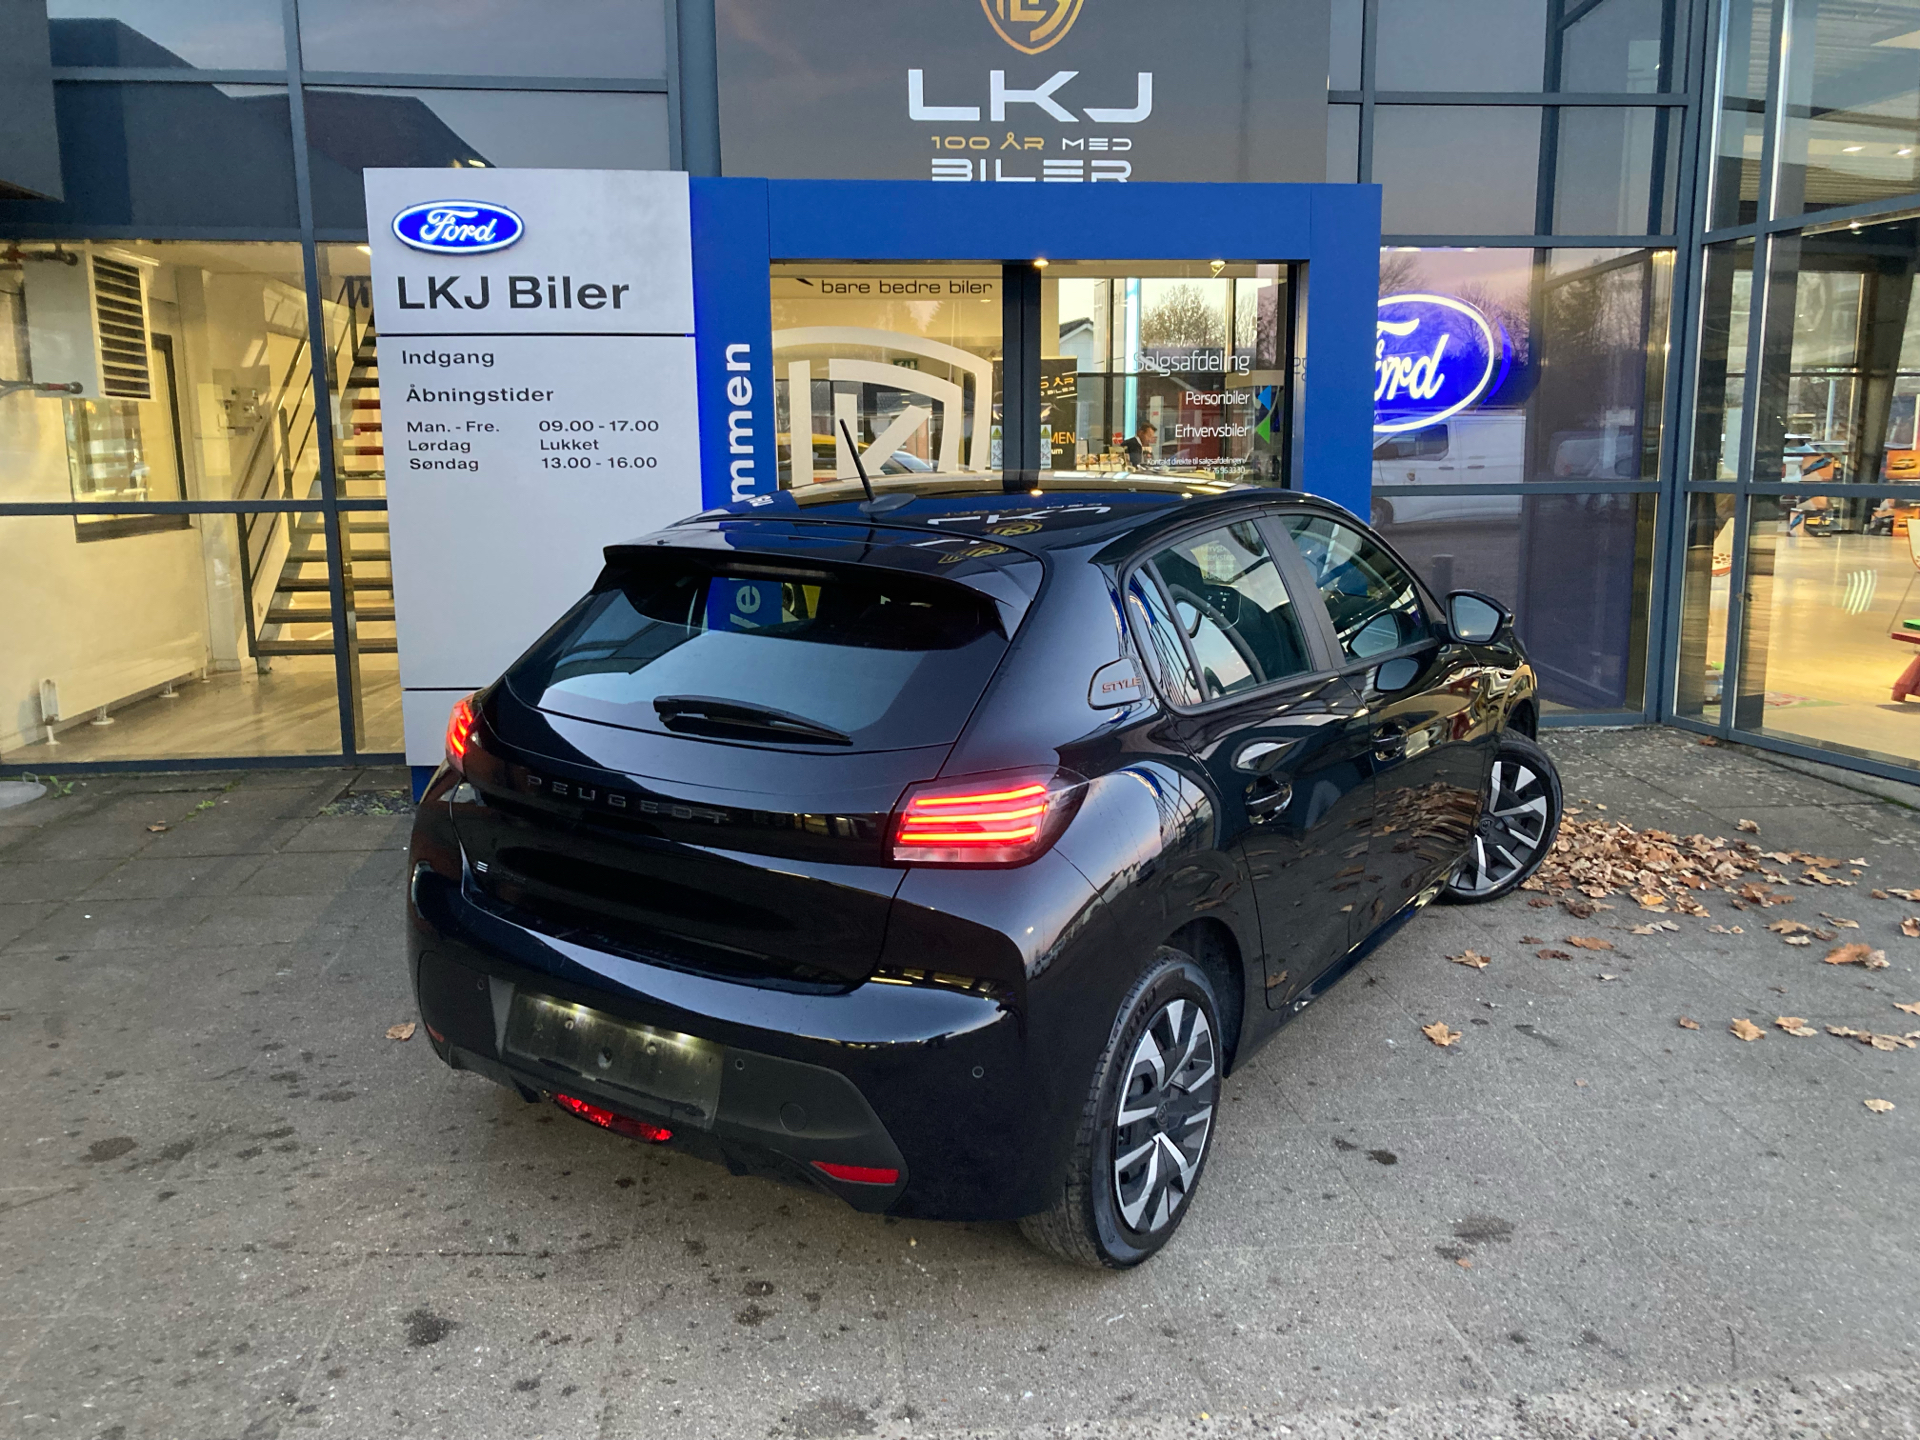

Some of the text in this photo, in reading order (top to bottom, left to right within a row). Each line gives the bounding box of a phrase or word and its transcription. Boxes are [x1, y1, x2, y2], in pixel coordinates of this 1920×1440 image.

[908, 69, 1153, 122] LKJ
[931, 131, 1133, 151] 100 ÅR MED
[931, 158, 1133, 183] BILER
[419, 209, 498, 242] Ford
[396, 275, 629, 310] LKJ Biler
[821, 280, 993, 294] bare bedre biler
[402, 350, 495, 367] Indgang
[1133, 350, 1250, 377] Salgsafdelng
[406, 384, 554, 405] Åbningstider
[1185, 391, 1250, 405] Personbiler
[406, 420, 451, 433] Man.
[466, 420, 500, 433] Fre.
[538, 420, 594, 432] 09.00
[609, 420, 659, 432] 17.00
[1175, 423, 1249, 438] Erhvervsbiler
[408, 439, 599, 454] Lørdag Lukket
[409, 458, 479, 472] Søndag
[541, 457, 591, 469] 13.00
[607, 457, 657, 469] 16.00
[1102, 677, 1141, 694] STYLE
[526, 775, 730, 824] PEUGEOT
